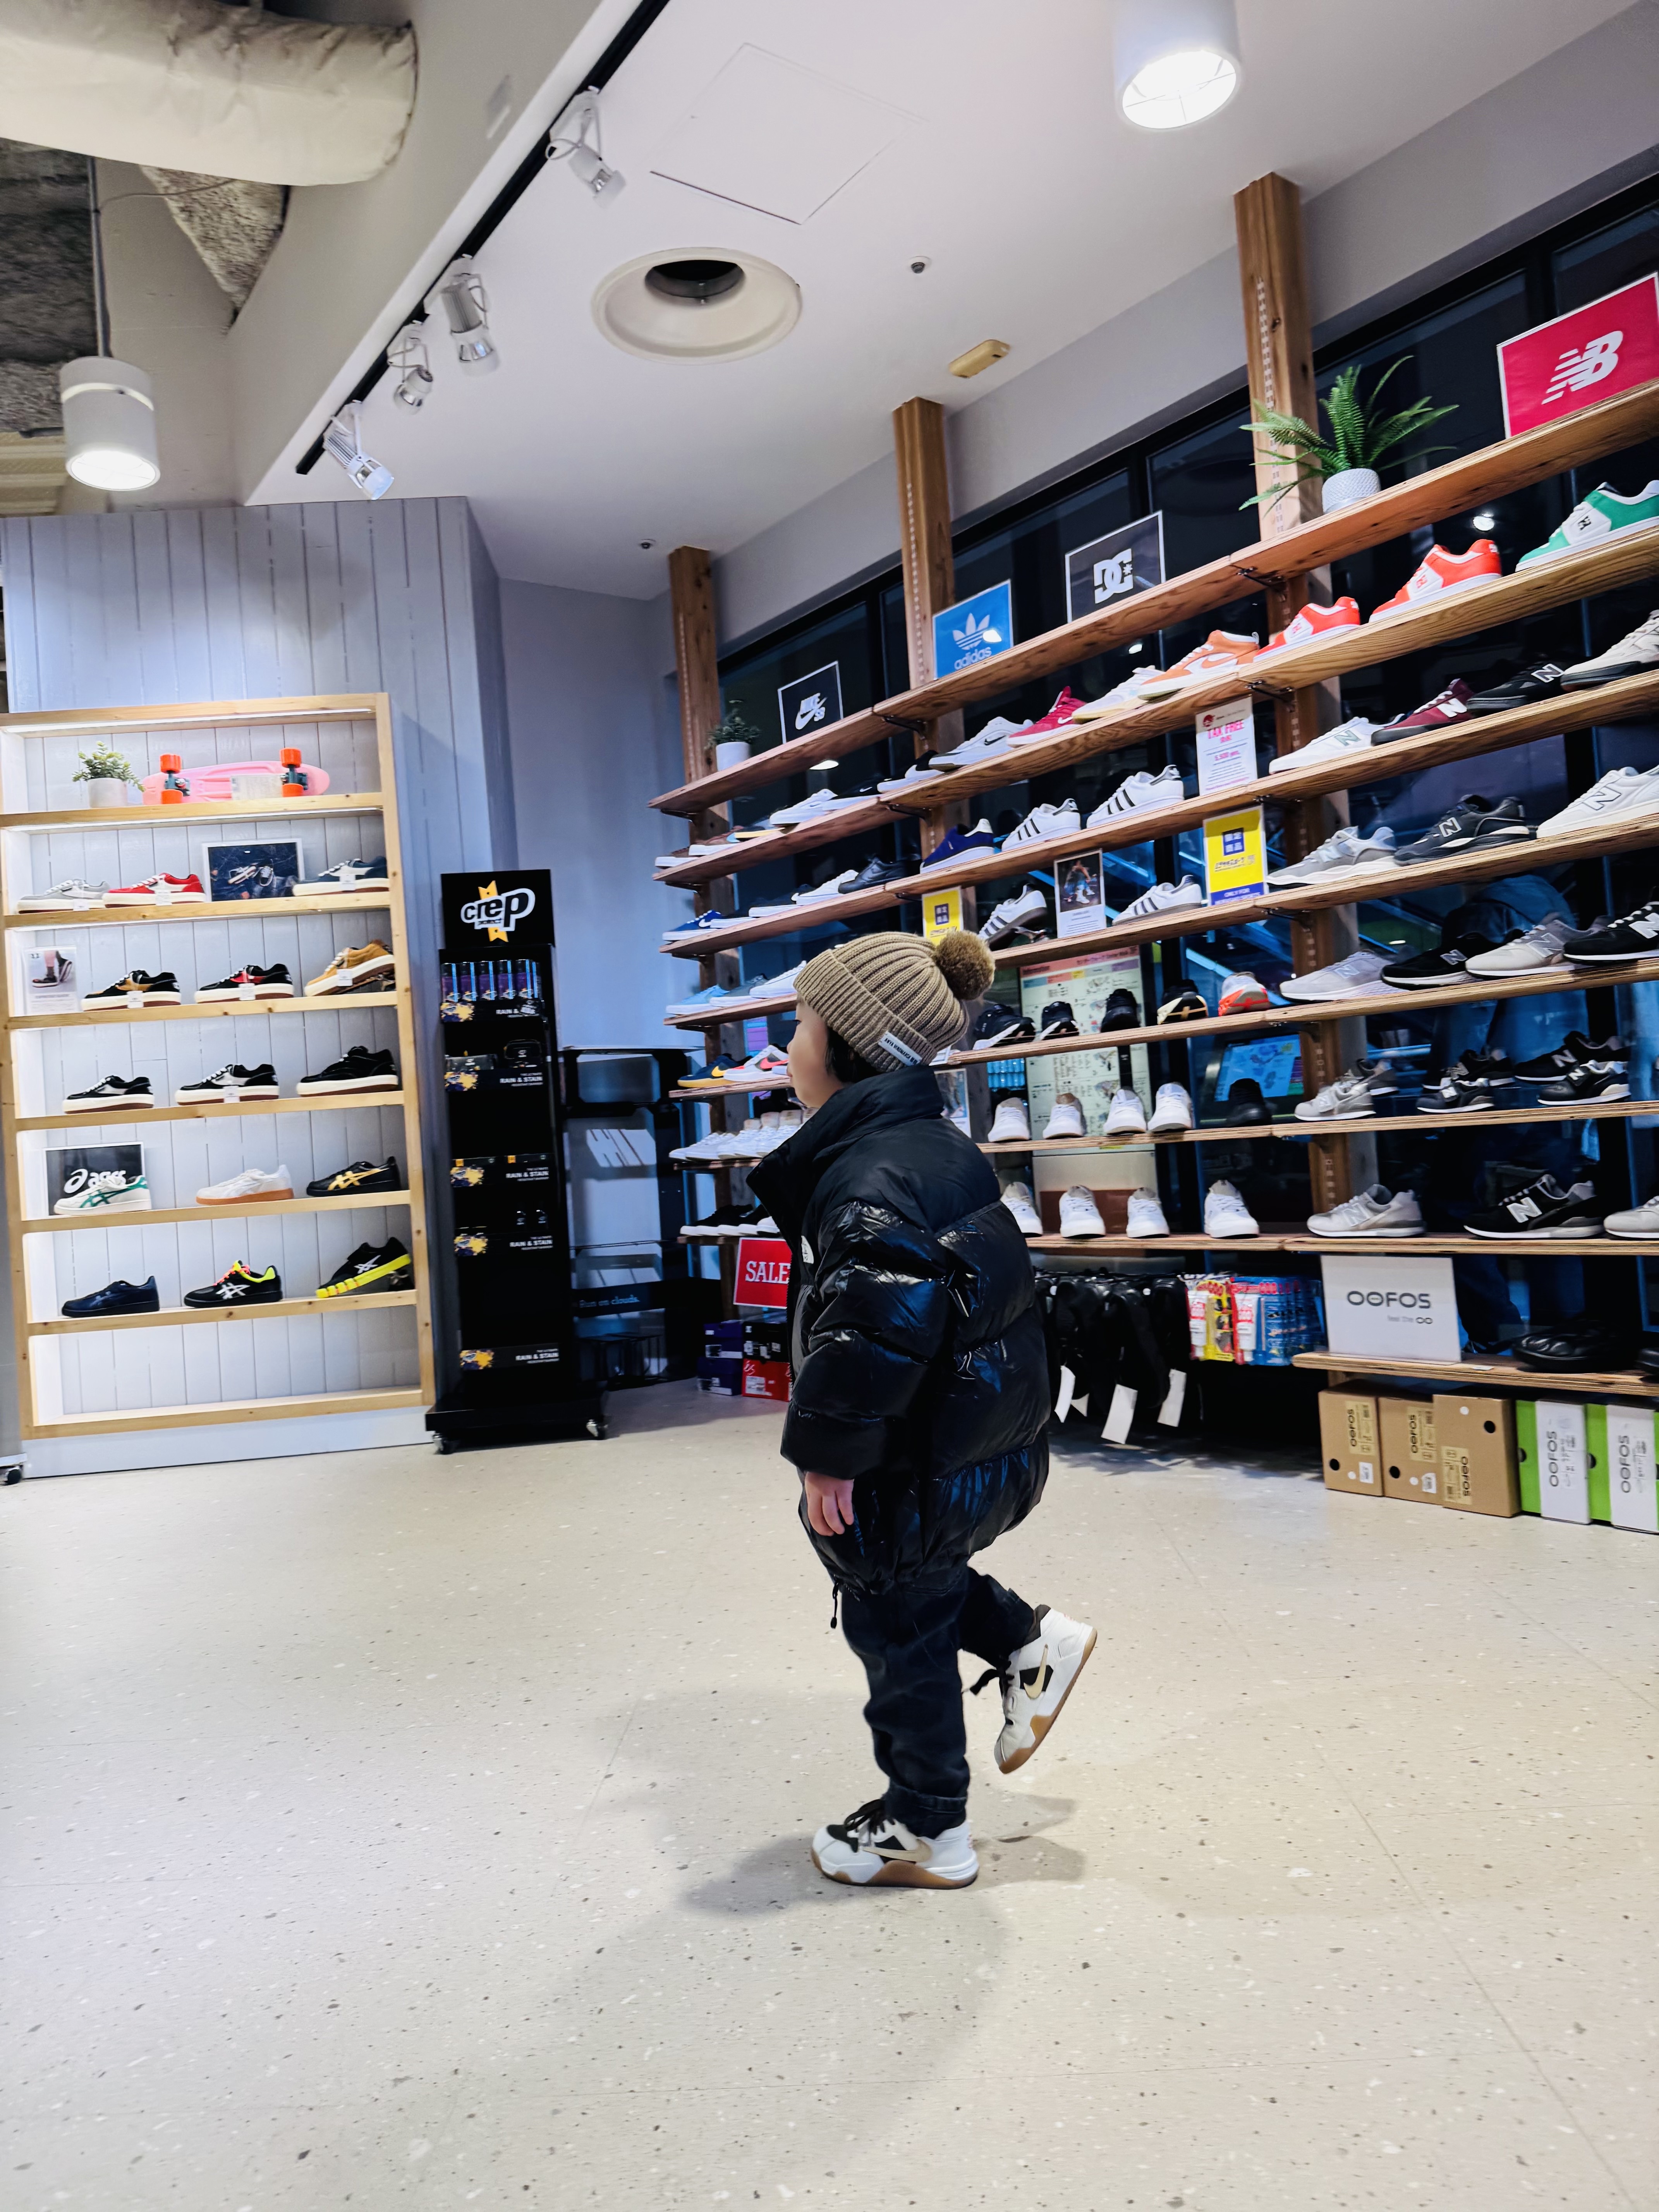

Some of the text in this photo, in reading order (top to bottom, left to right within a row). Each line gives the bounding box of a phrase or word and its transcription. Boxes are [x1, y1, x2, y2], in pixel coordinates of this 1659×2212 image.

[1093, 548, 1133, 604] DC
[954, 646, 992, 670] adidas
[463, 890, 532, 929] crep
[1506, 1197, 1542, 1223] N
[745, 1261, 791, 1284] SALE
[1347, 1290, 1431, 1309] OOFOS
[1346, 1408, 1358, 1447] OOFOS
[1546, 1431, 1559, 1487] OOFOS
[1618, 1435, 1632, 1494] OOFOS
